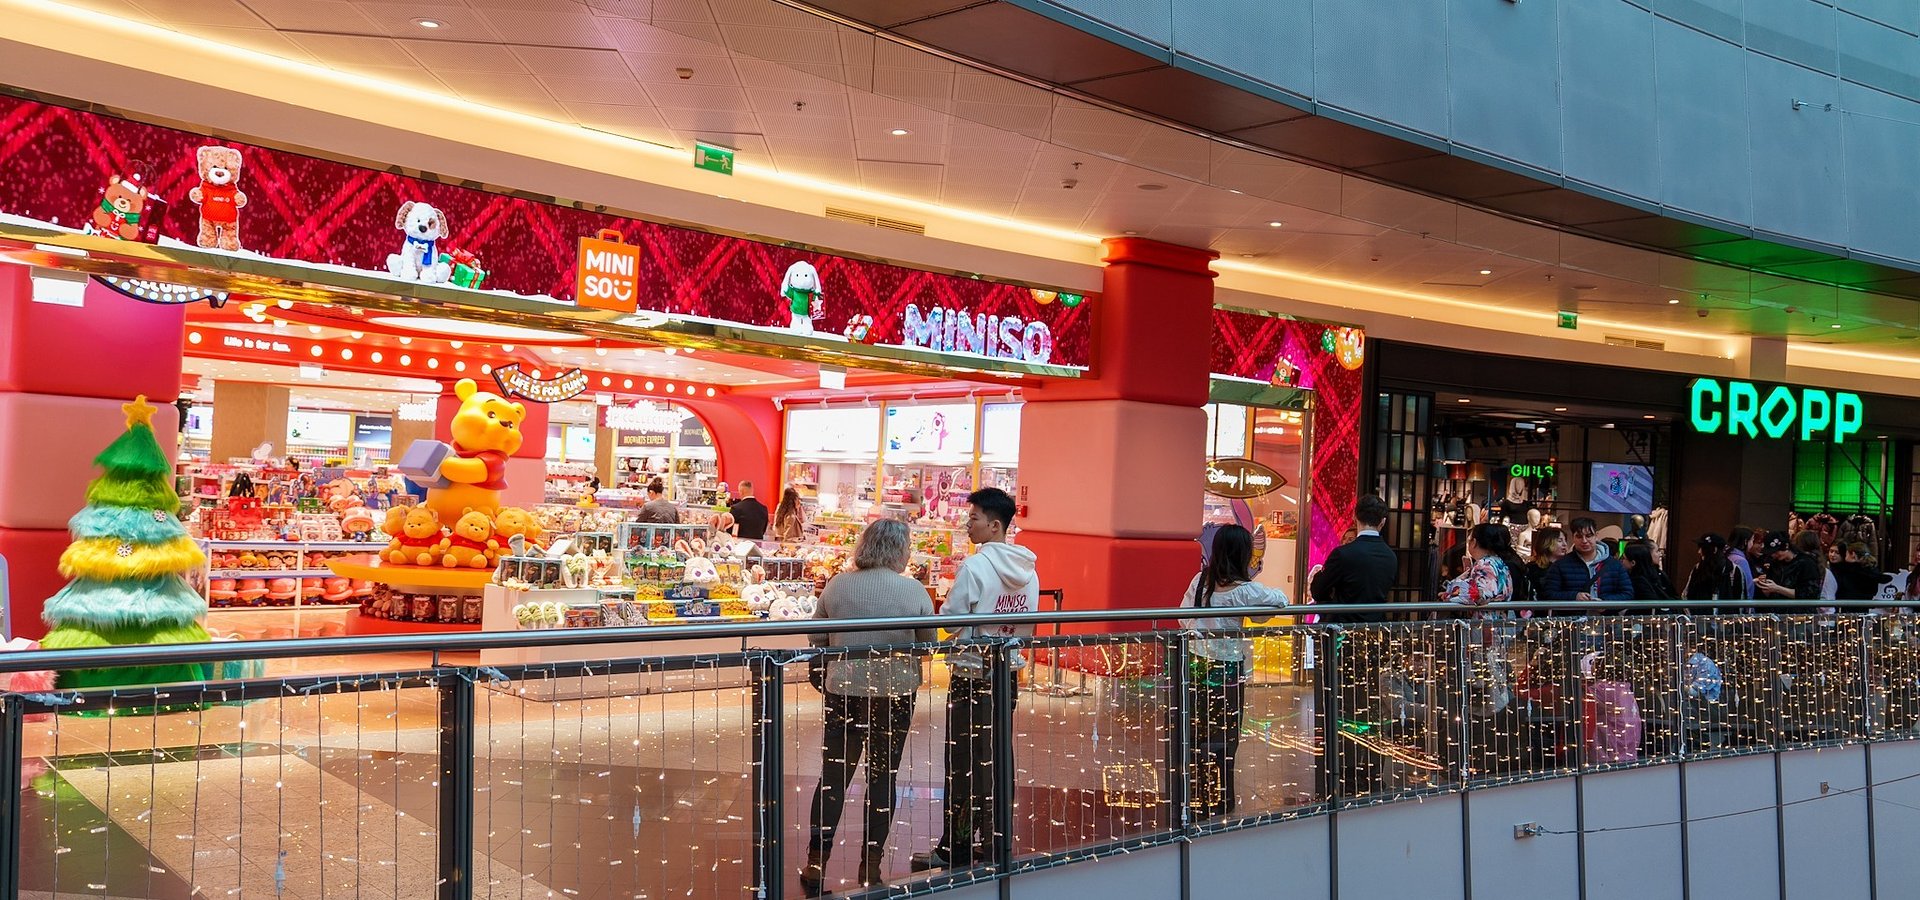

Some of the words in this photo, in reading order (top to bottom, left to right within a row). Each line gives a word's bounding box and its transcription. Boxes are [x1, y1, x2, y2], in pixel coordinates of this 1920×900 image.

[586, 249, 634, 277] MINI
[224, 336, 243, 347] Life
[244, 338, 254, 349] is
[255, 339, 271, 350] for
[903, 303, 1051, 363] MINISO
[510, 374, 530, 391] LIFE
[530, 384, 541, 394] IS
[541, 385, 561, 396] FOR
[1691, 378, 1863, 444] CROPP
[624, 435, 647, 444] HOGWARTS
[647, 435, 666, 445] EXPRESS
[1206, 467, 1238, 489] Disney
[1245, 474, 1272, 486] MINISO
[995, 594, 1026, 609] MINISO
